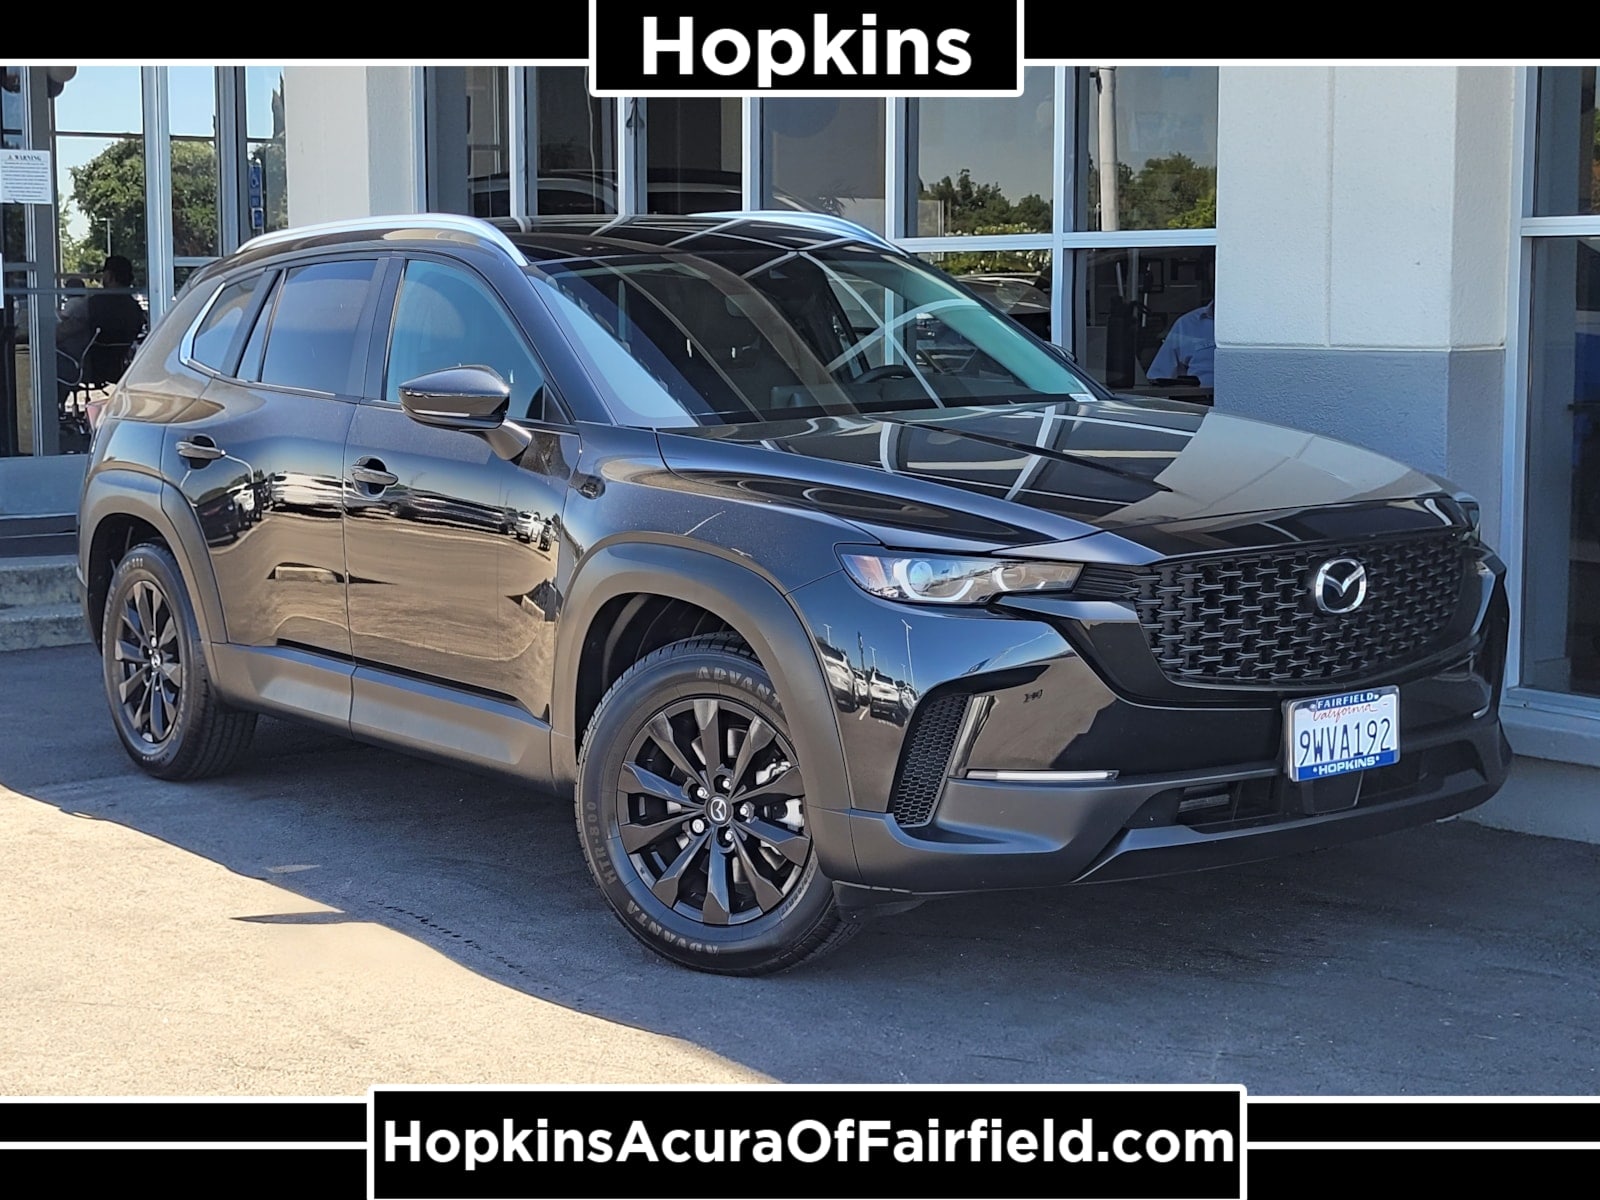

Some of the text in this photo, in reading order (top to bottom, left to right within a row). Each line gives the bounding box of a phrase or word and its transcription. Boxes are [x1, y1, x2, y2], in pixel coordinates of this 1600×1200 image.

[697, 666, 781, 709] ADVANT
[1317, 692, 1374, 709] FAIRFIELD
[1300, 717, 1391, 766] 9WVA192
[1318, 756, 1375, 775] HOPKINS
[626, 900, 719, 954] ADVANTA
